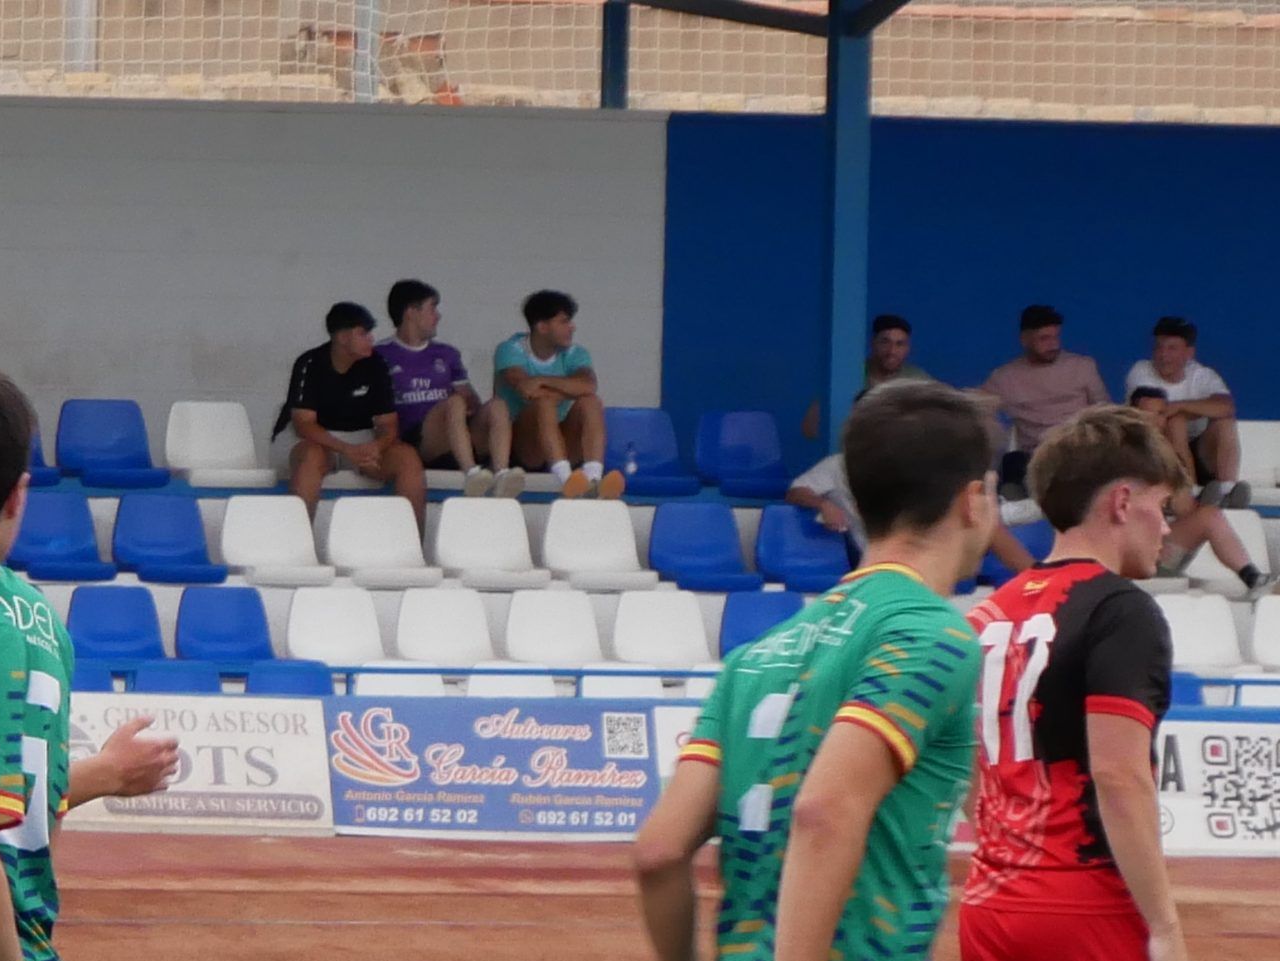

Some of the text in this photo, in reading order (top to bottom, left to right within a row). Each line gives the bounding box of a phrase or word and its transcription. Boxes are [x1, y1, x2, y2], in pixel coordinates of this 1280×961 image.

[412, 377, 431, 389] Fly
[394, 388, 449, 404] Emirates
[206, 710, 309, 736] ASESOR
[424, 742, 647, 789] García Ramírez
[115, 796, 319, 815] SIEMPRE A SU SERVICIO
[366, 807, 478, 823] 692 61 52 02
[535, 810, 636, 825] 692 61 52 01
